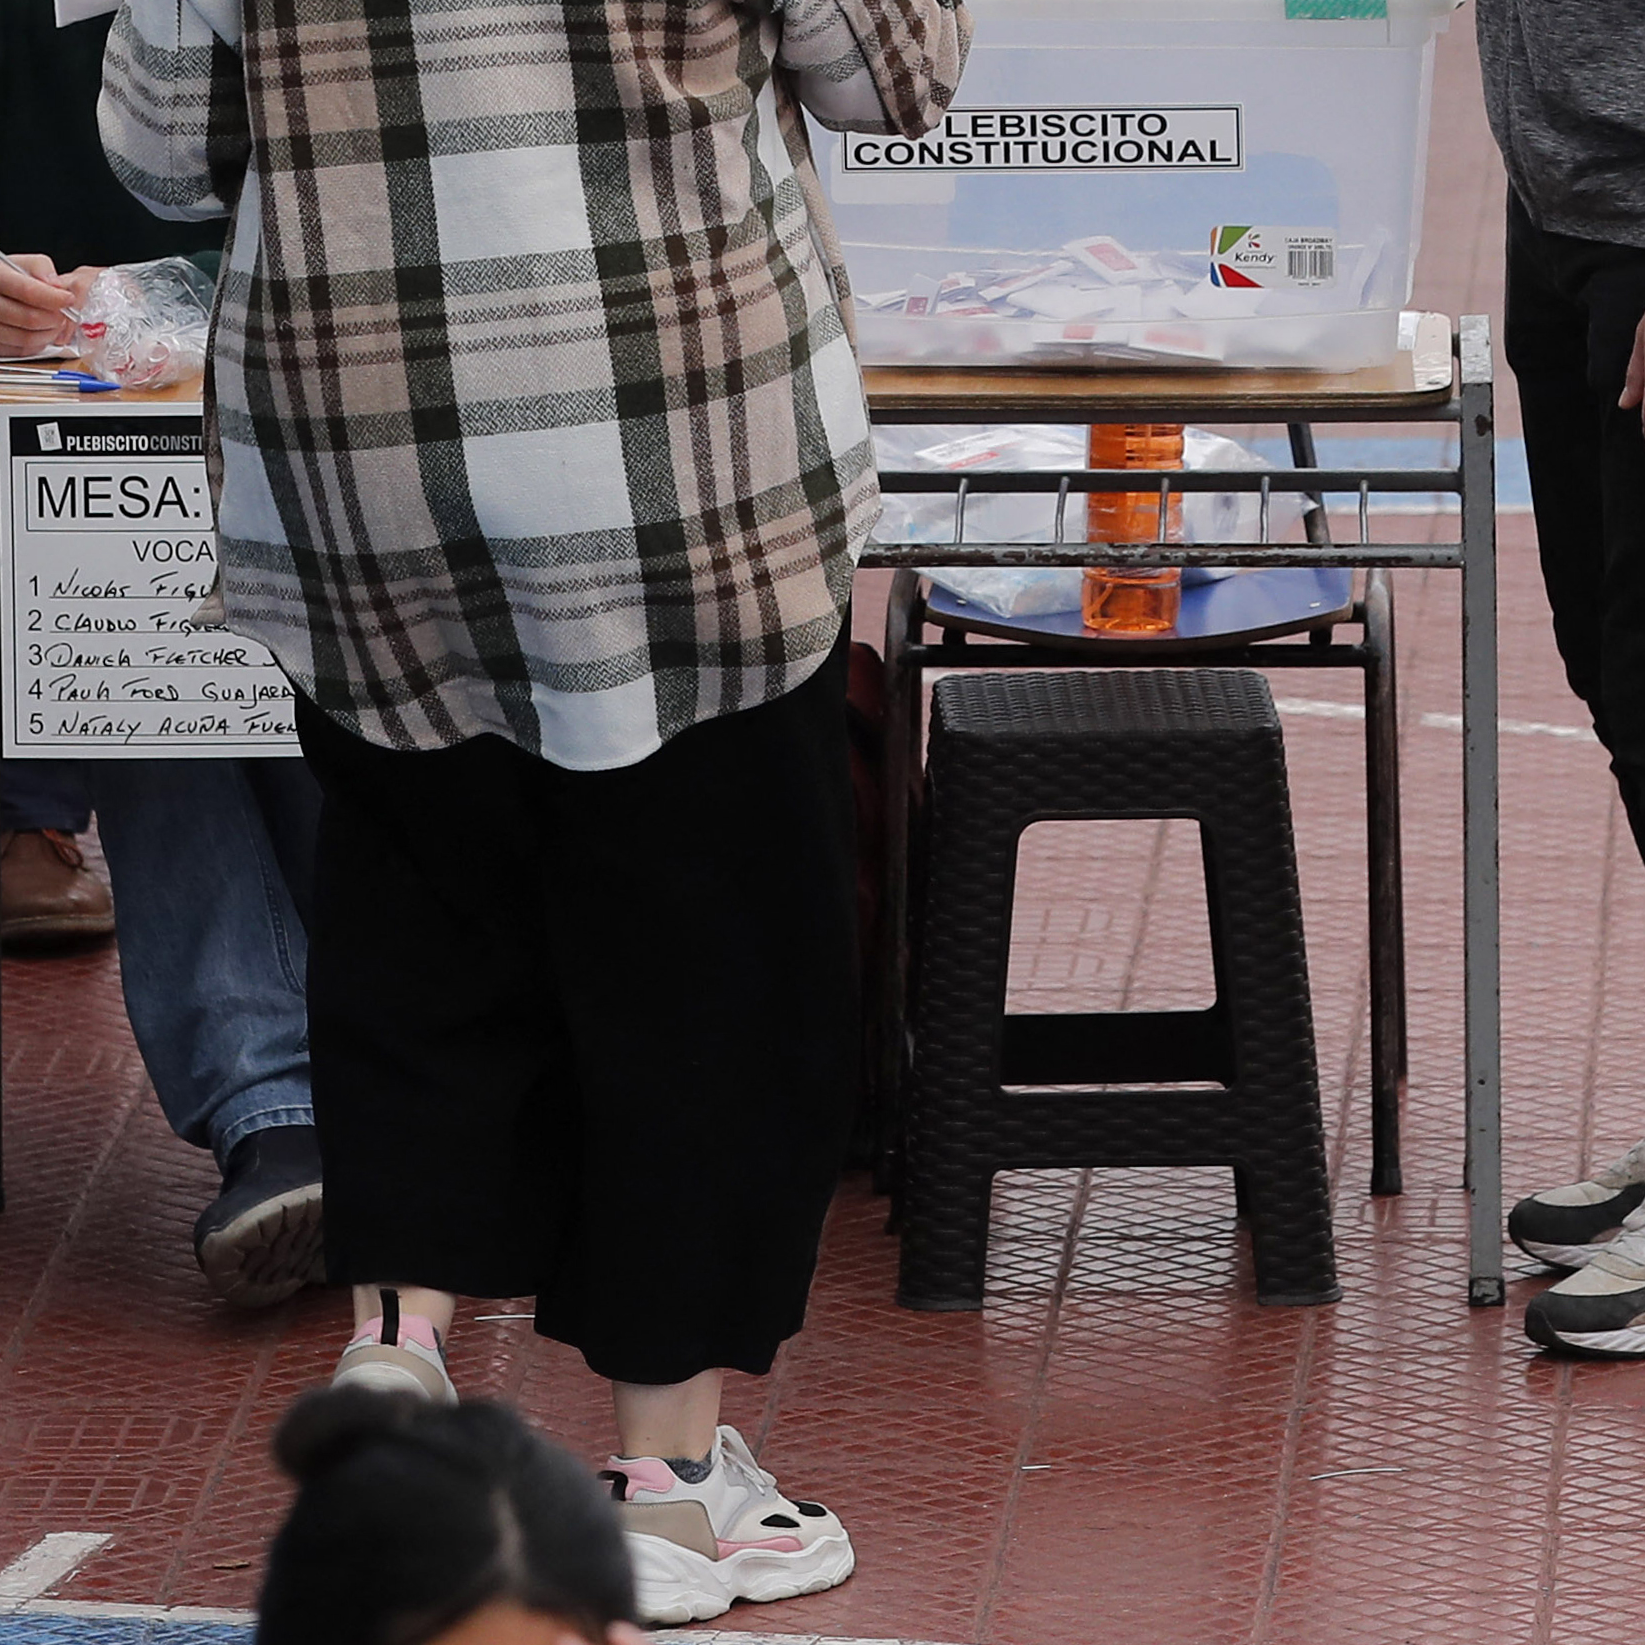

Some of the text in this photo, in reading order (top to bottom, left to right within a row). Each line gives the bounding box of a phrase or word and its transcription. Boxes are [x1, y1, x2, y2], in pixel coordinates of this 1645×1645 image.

[933, 113, 1168, 138] LEBISCITO
[853, 140, 1233, 166] CONSTITUCIONAL
[1235, 252, 1274, 264] Kendy
[66, 435, 149, 451] PLEBISCITO
[37, 475, 201, 519] MESA:
[132, 539, 215, 563] VOCA
[29, 575, 38, 596] 1
[28, 609, 42, 631] 2
[28, 644, 42, 666] 3
[28, 678, 43, 700] 4
[29, 713, 44, 735] 5
